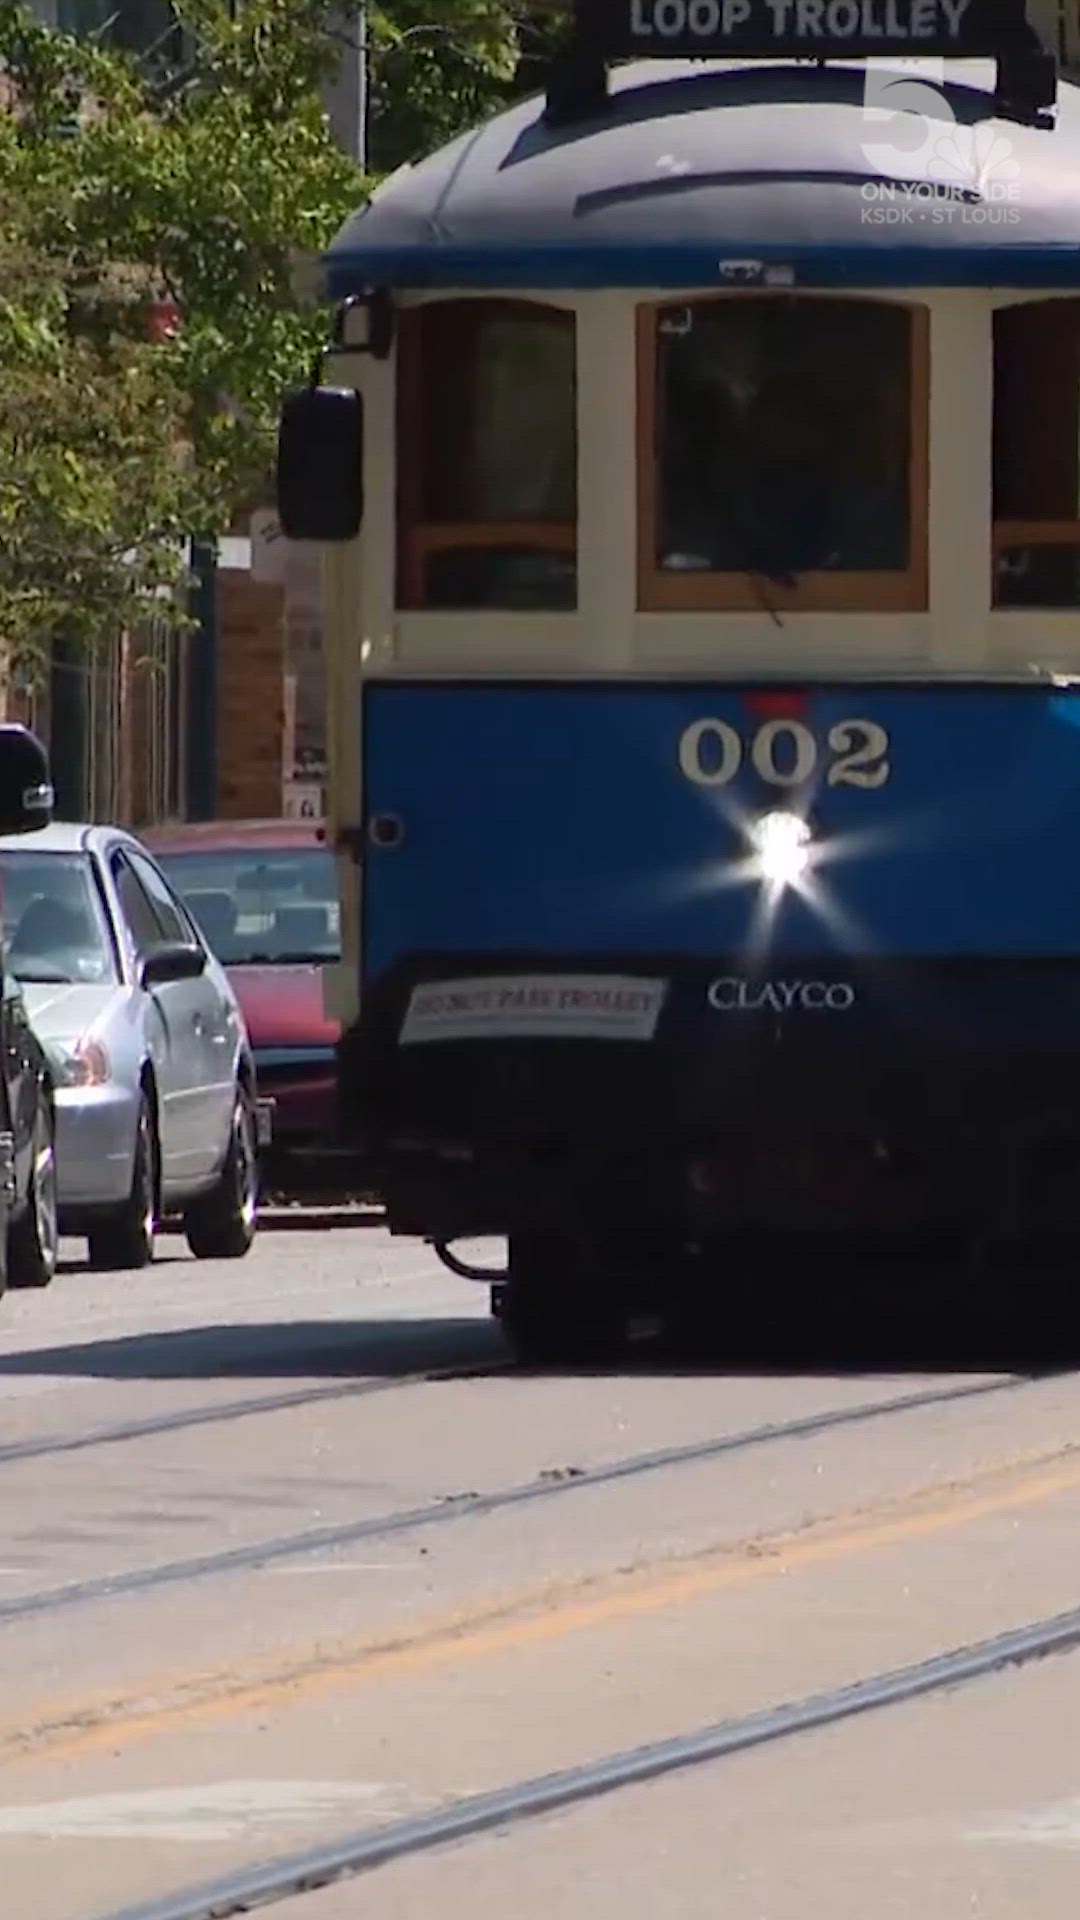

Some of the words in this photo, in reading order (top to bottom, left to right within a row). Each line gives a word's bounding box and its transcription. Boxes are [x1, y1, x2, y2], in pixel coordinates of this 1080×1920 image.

[630, 0, 750, 36] LOOP
[765, 0, 968, 37] TROLLEY
[679, 718, 890, 788] 002
[708, 977, 856, 1012] CLAYCO
